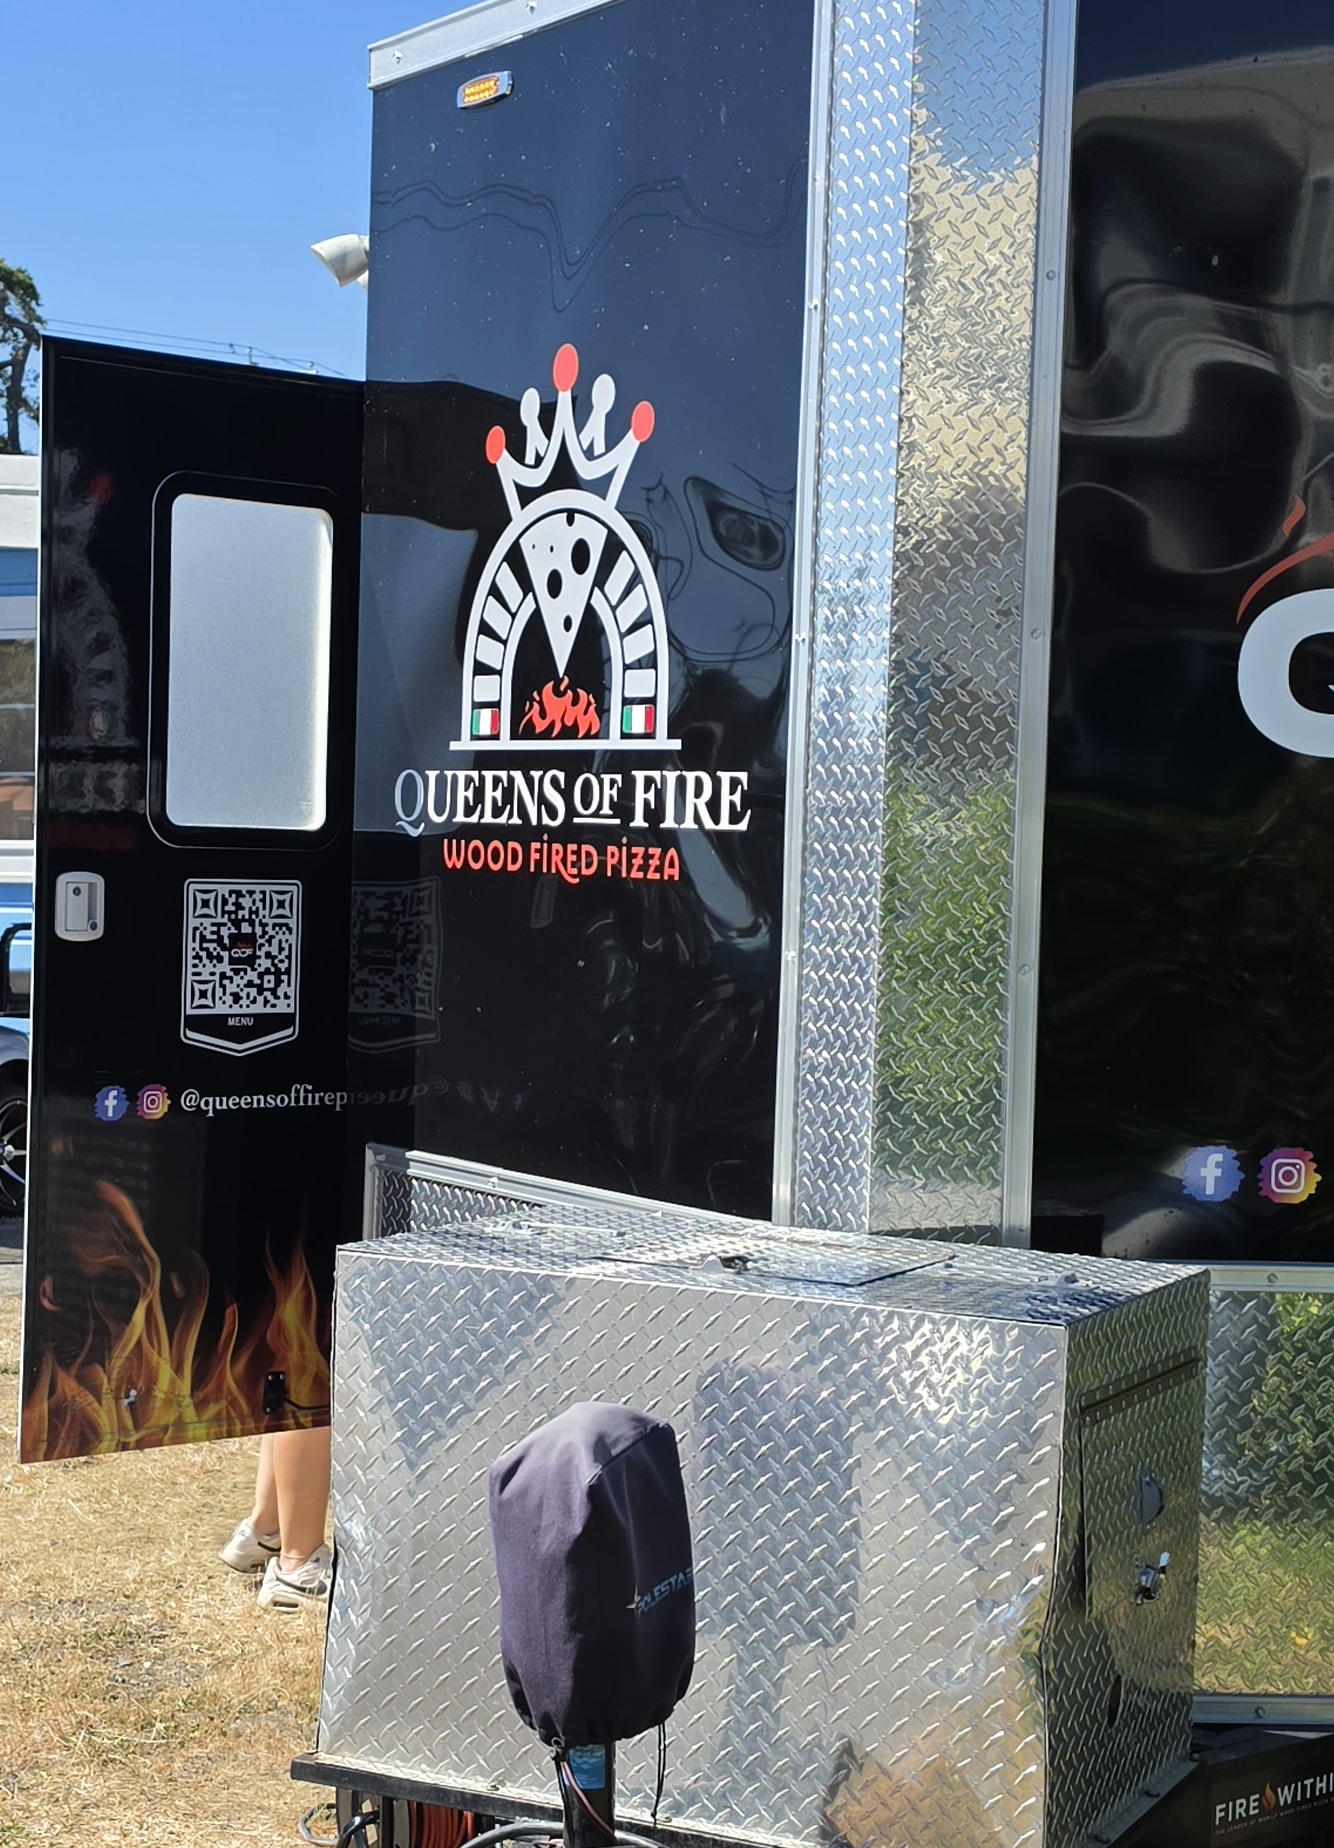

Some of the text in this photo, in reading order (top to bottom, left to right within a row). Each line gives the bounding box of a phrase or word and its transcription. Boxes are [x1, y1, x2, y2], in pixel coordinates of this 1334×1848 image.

[394, 768, 752, 838] QUEENS OF FIRE
[442, 837, 523, 873] WOOD
[227, 1016, 254, 1026] MENU
[1215, 1793, 1261, 1826] FIRE
